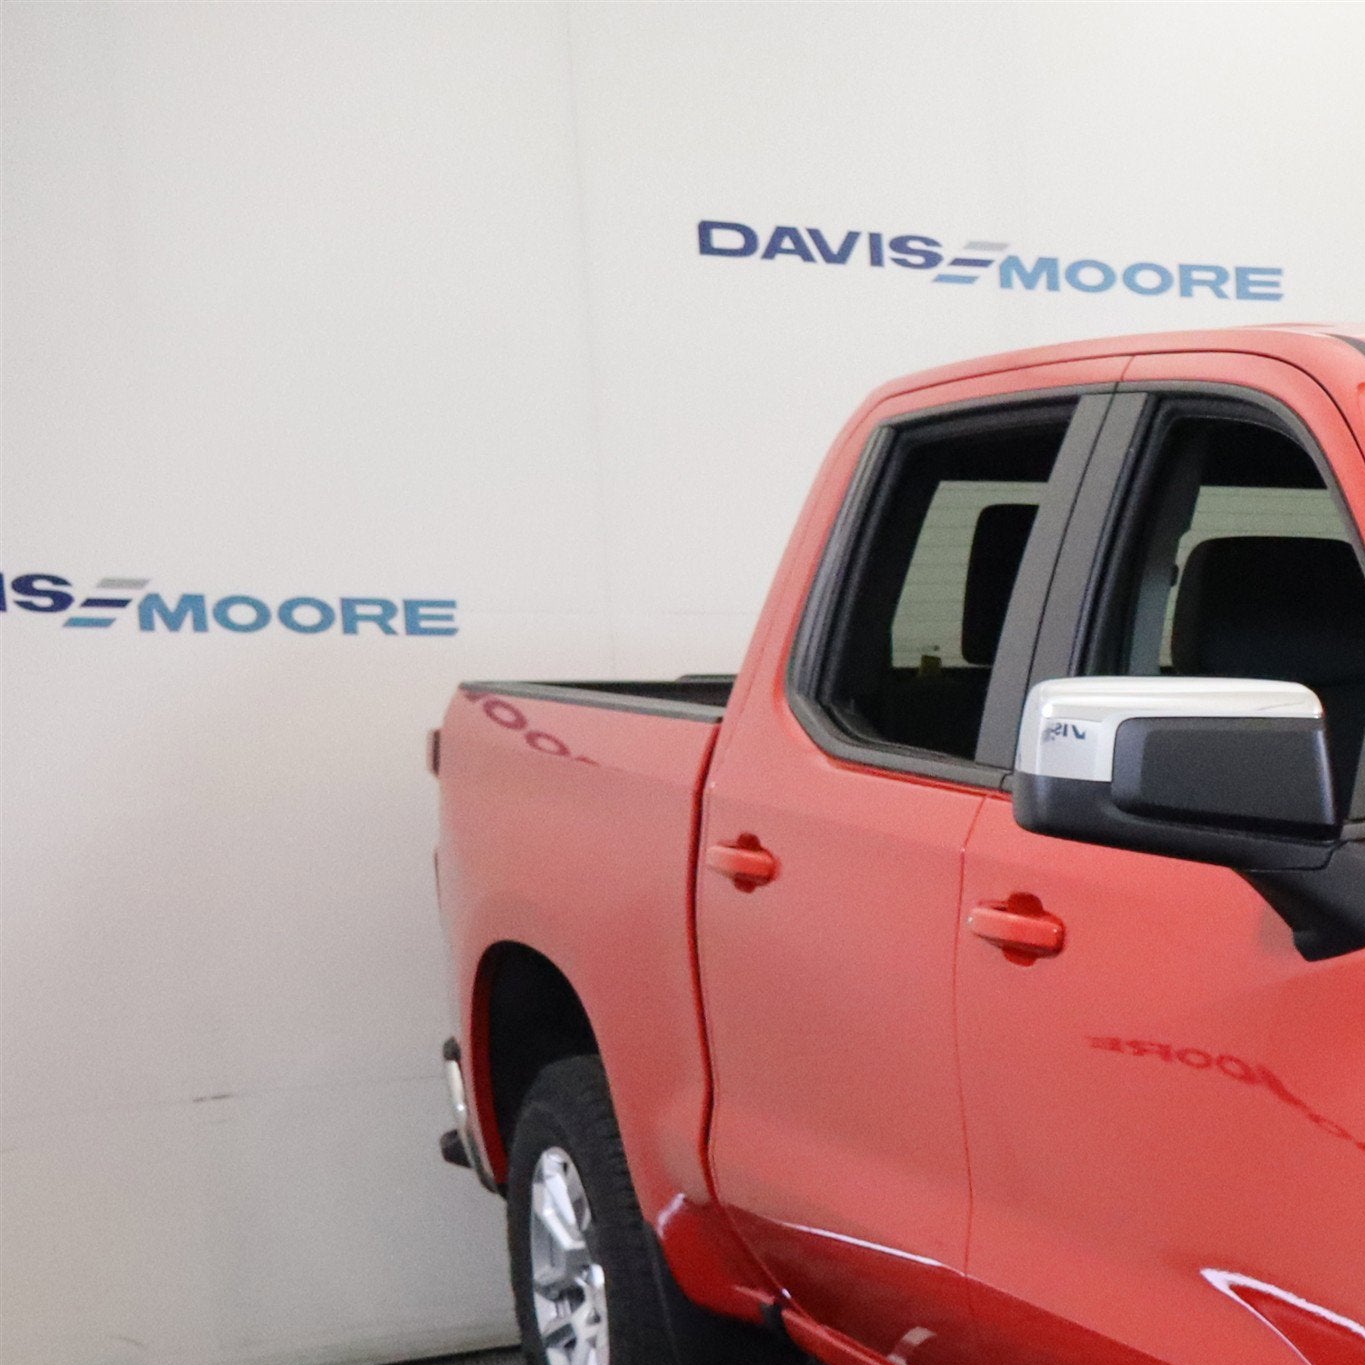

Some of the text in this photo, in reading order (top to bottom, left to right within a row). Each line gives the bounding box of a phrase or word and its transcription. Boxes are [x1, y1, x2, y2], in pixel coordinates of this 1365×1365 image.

[697, 219, 1284, 302] DAVIS MOORE
[137, 592, 459, 637] MOORE
